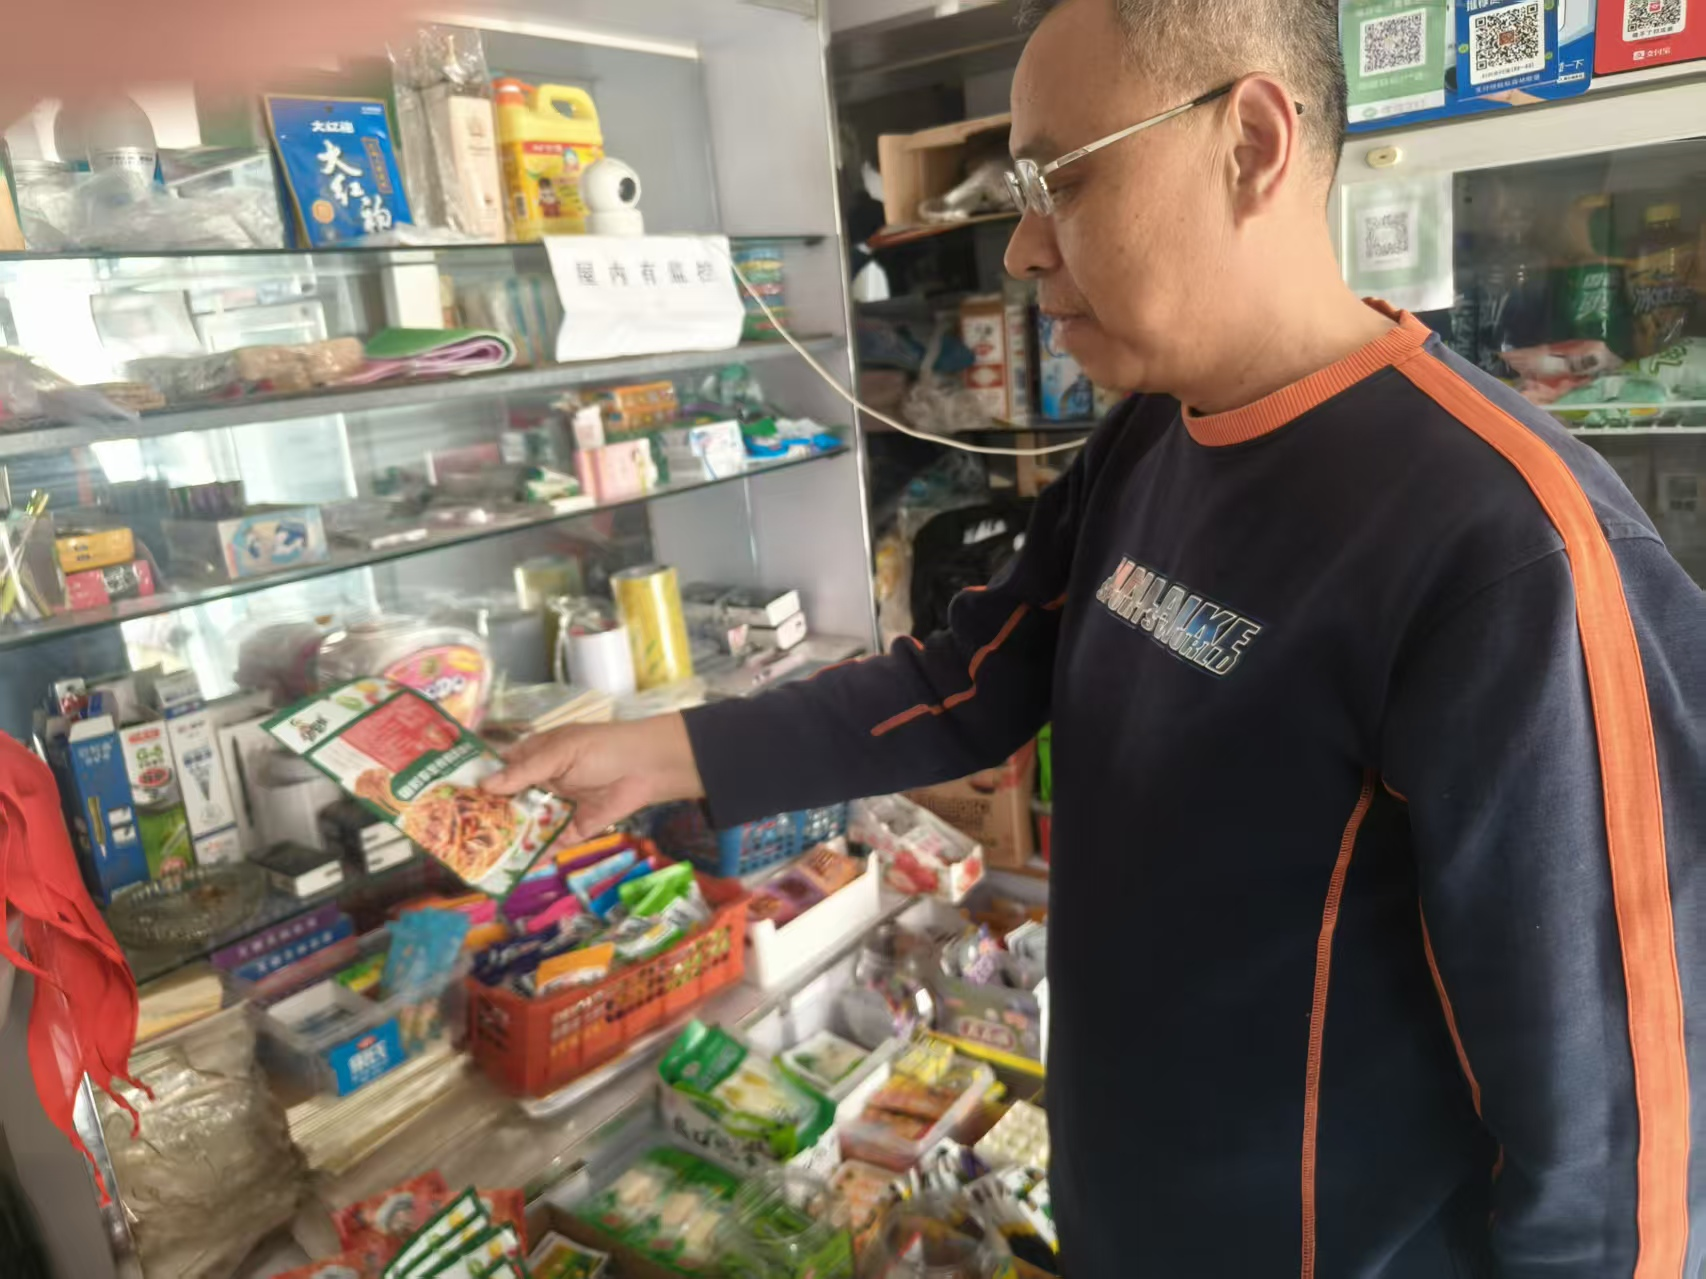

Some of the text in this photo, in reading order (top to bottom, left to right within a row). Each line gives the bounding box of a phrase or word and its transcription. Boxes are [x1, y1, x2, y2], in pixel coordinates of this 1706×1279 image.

[1647, 46, 1671, 57] 支付宝
[310, 120, 355, 134] 大红袍
[575, 261, 715, 286] 屋内有监控
